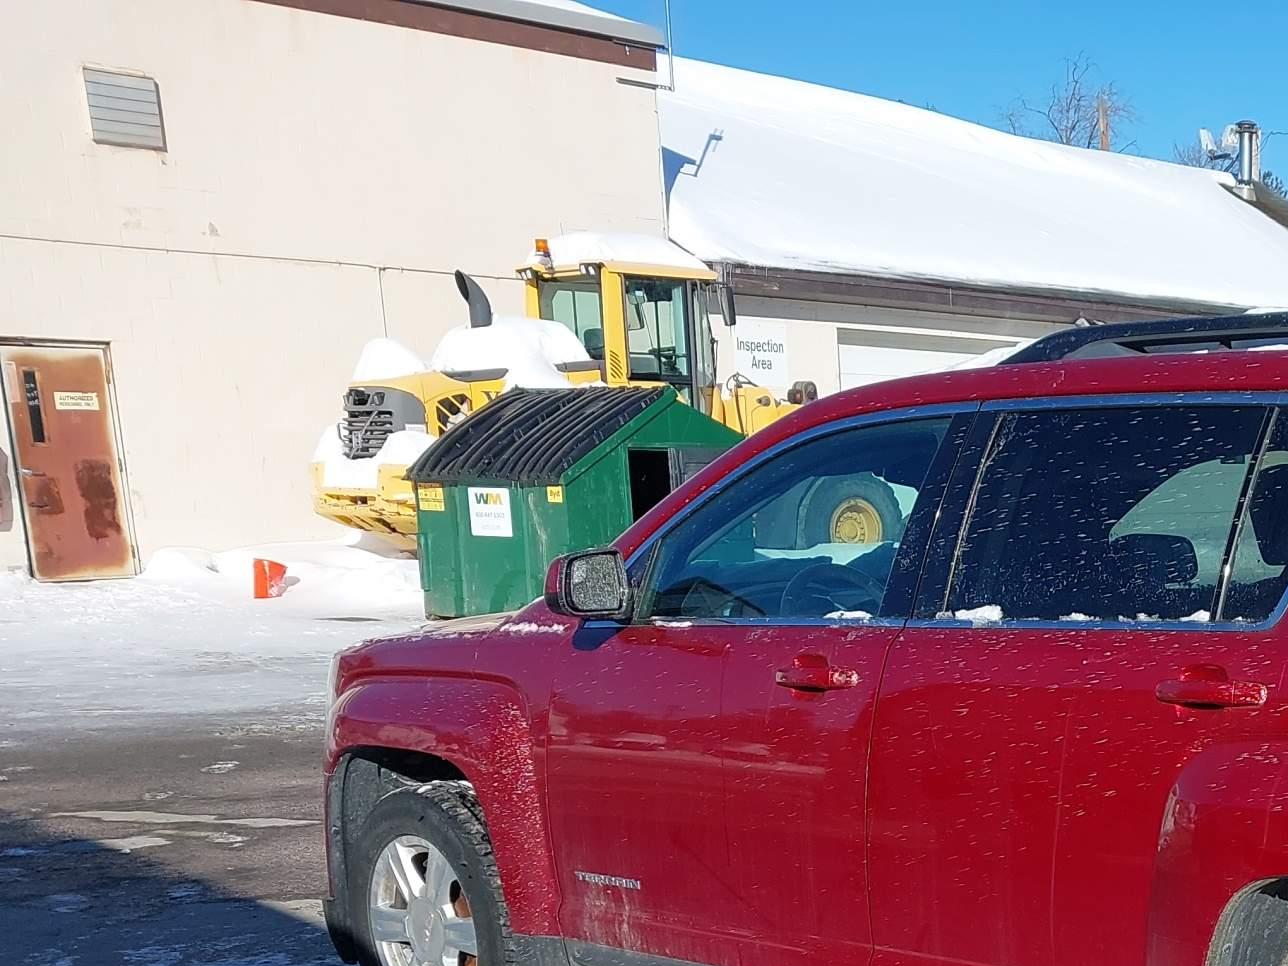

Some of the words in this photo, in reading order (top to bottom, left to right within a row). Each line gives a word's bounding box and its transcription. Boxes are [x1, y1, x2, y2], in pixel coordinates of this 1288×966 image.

[737, 337, 784, 354] Inspection
[751, 355, 772, 370] Area
[474, 492, 504, 505] WM
